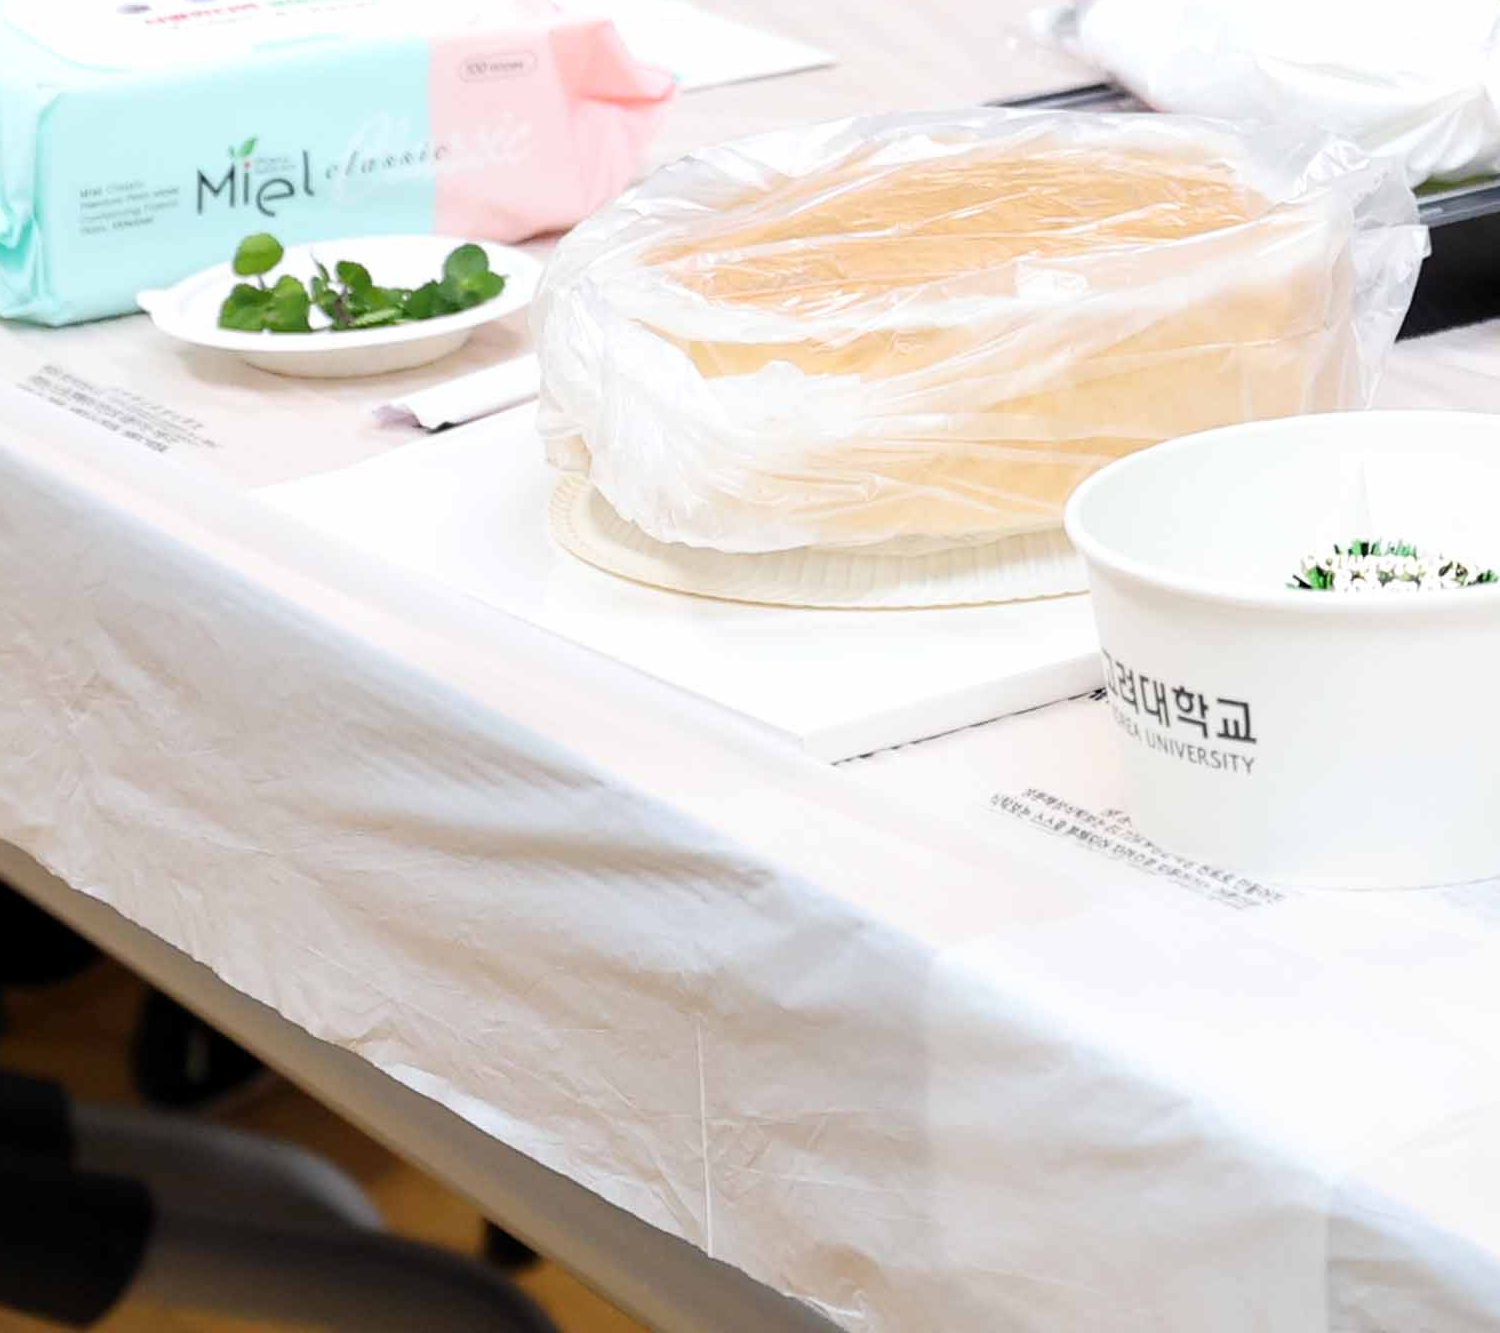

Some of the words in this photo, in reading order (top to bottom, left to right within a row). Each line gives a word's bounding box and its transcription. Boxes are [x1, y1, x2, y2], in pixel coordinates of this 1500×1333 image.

[195, 146, 316, 217] Miel
[323, 142, 453, 180] classic
[1102, 646, 1258, 745] 고려대학교
[1144, 727, 1256, 776] UNIVERSITY
